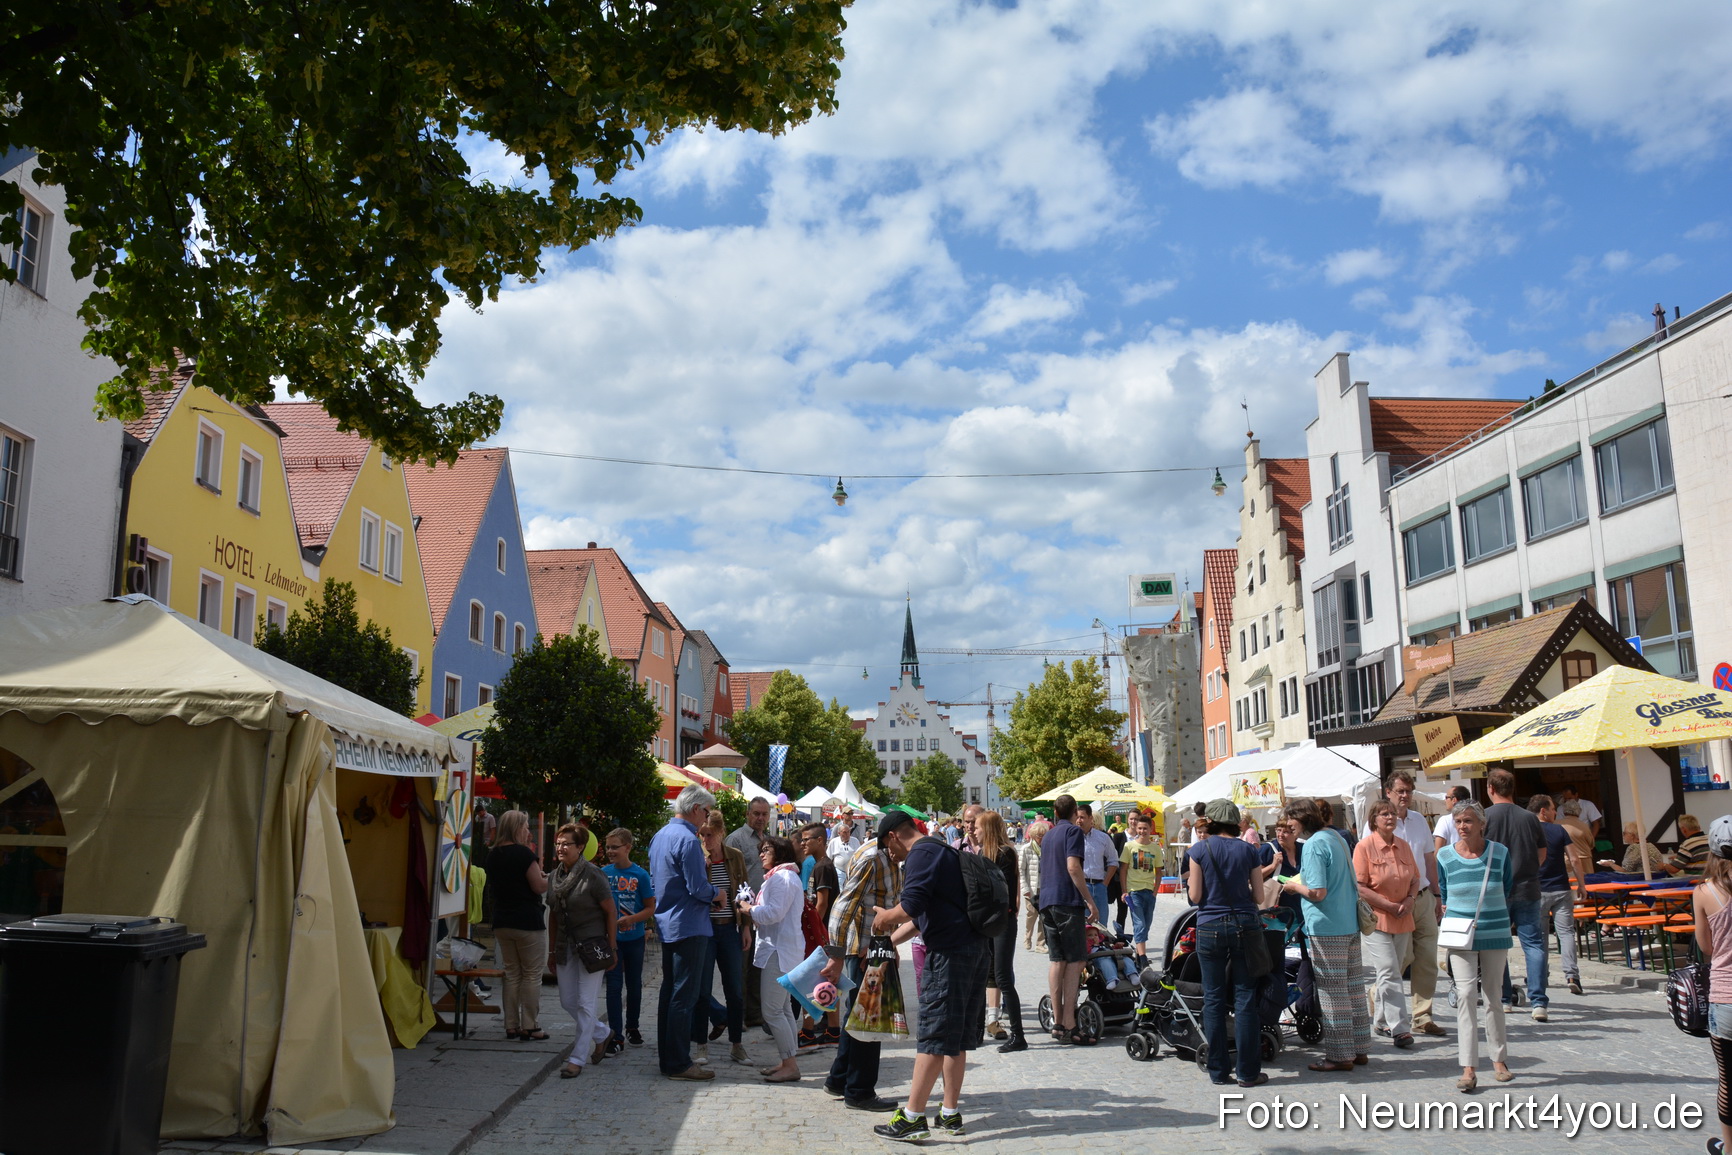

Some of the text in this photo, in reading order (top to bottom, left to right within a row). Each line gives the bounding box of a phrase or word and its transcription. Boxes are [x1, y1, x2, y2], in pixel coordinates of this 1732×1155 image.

[214, 534, 308, 598] HOTEL Lehmeier
[1145, 582, 1171, 594] DAV
[1635, 692, 1718, 727] Glossner
[1424, 725, 1442, 743] Kleine
[1094, 782, 1133, 793] Glossner
[1697, 994, 1708, 1016] NEW
